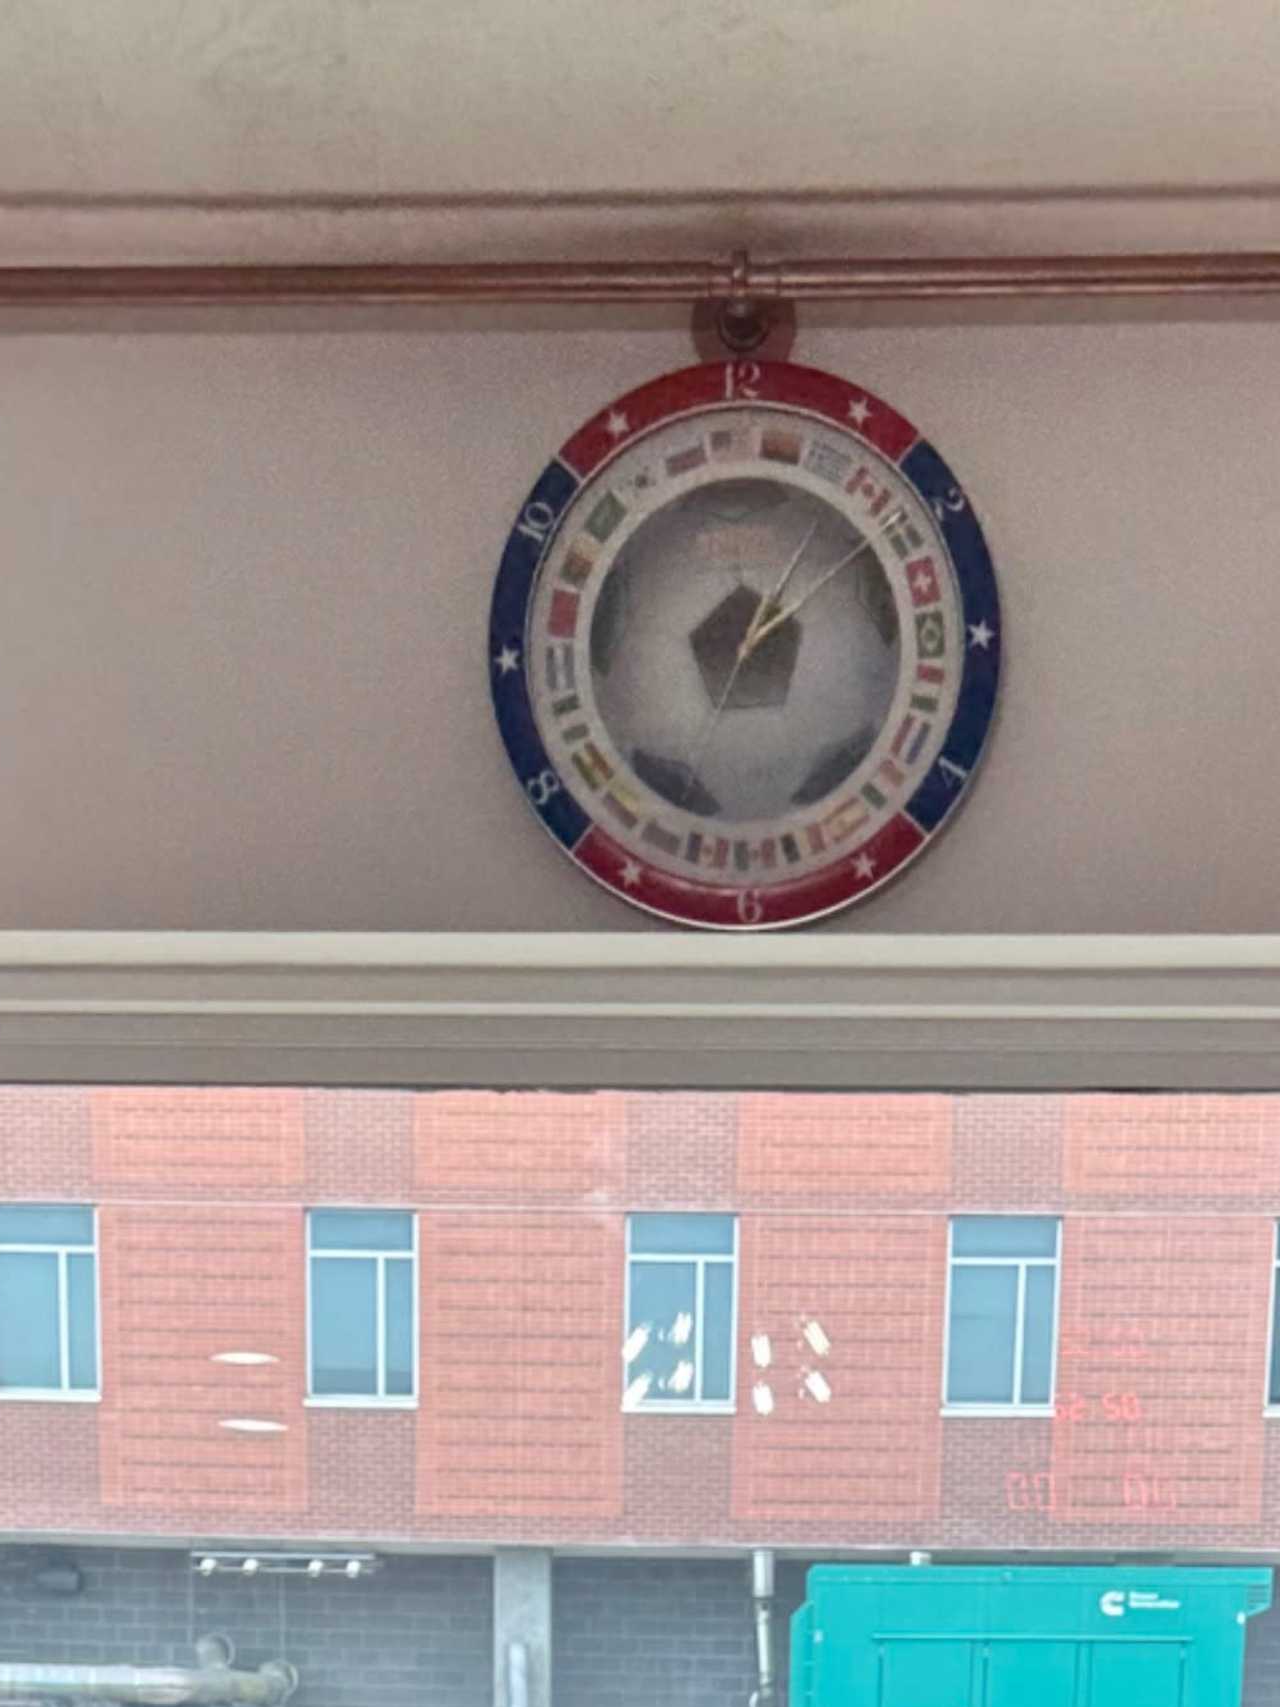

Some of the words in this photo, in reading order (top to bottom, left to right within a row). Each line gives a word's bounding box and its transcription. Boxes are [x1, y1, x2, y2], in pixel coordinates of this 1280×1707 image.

[723, 362, 762, 399] 12
[931, 487, 967, 522] 2
[516, 501, 558, 545] 10
[525, 769, 564, 805] 8
[937, 755, 969, 789] 4
[735, 890, 763, 924] 6
